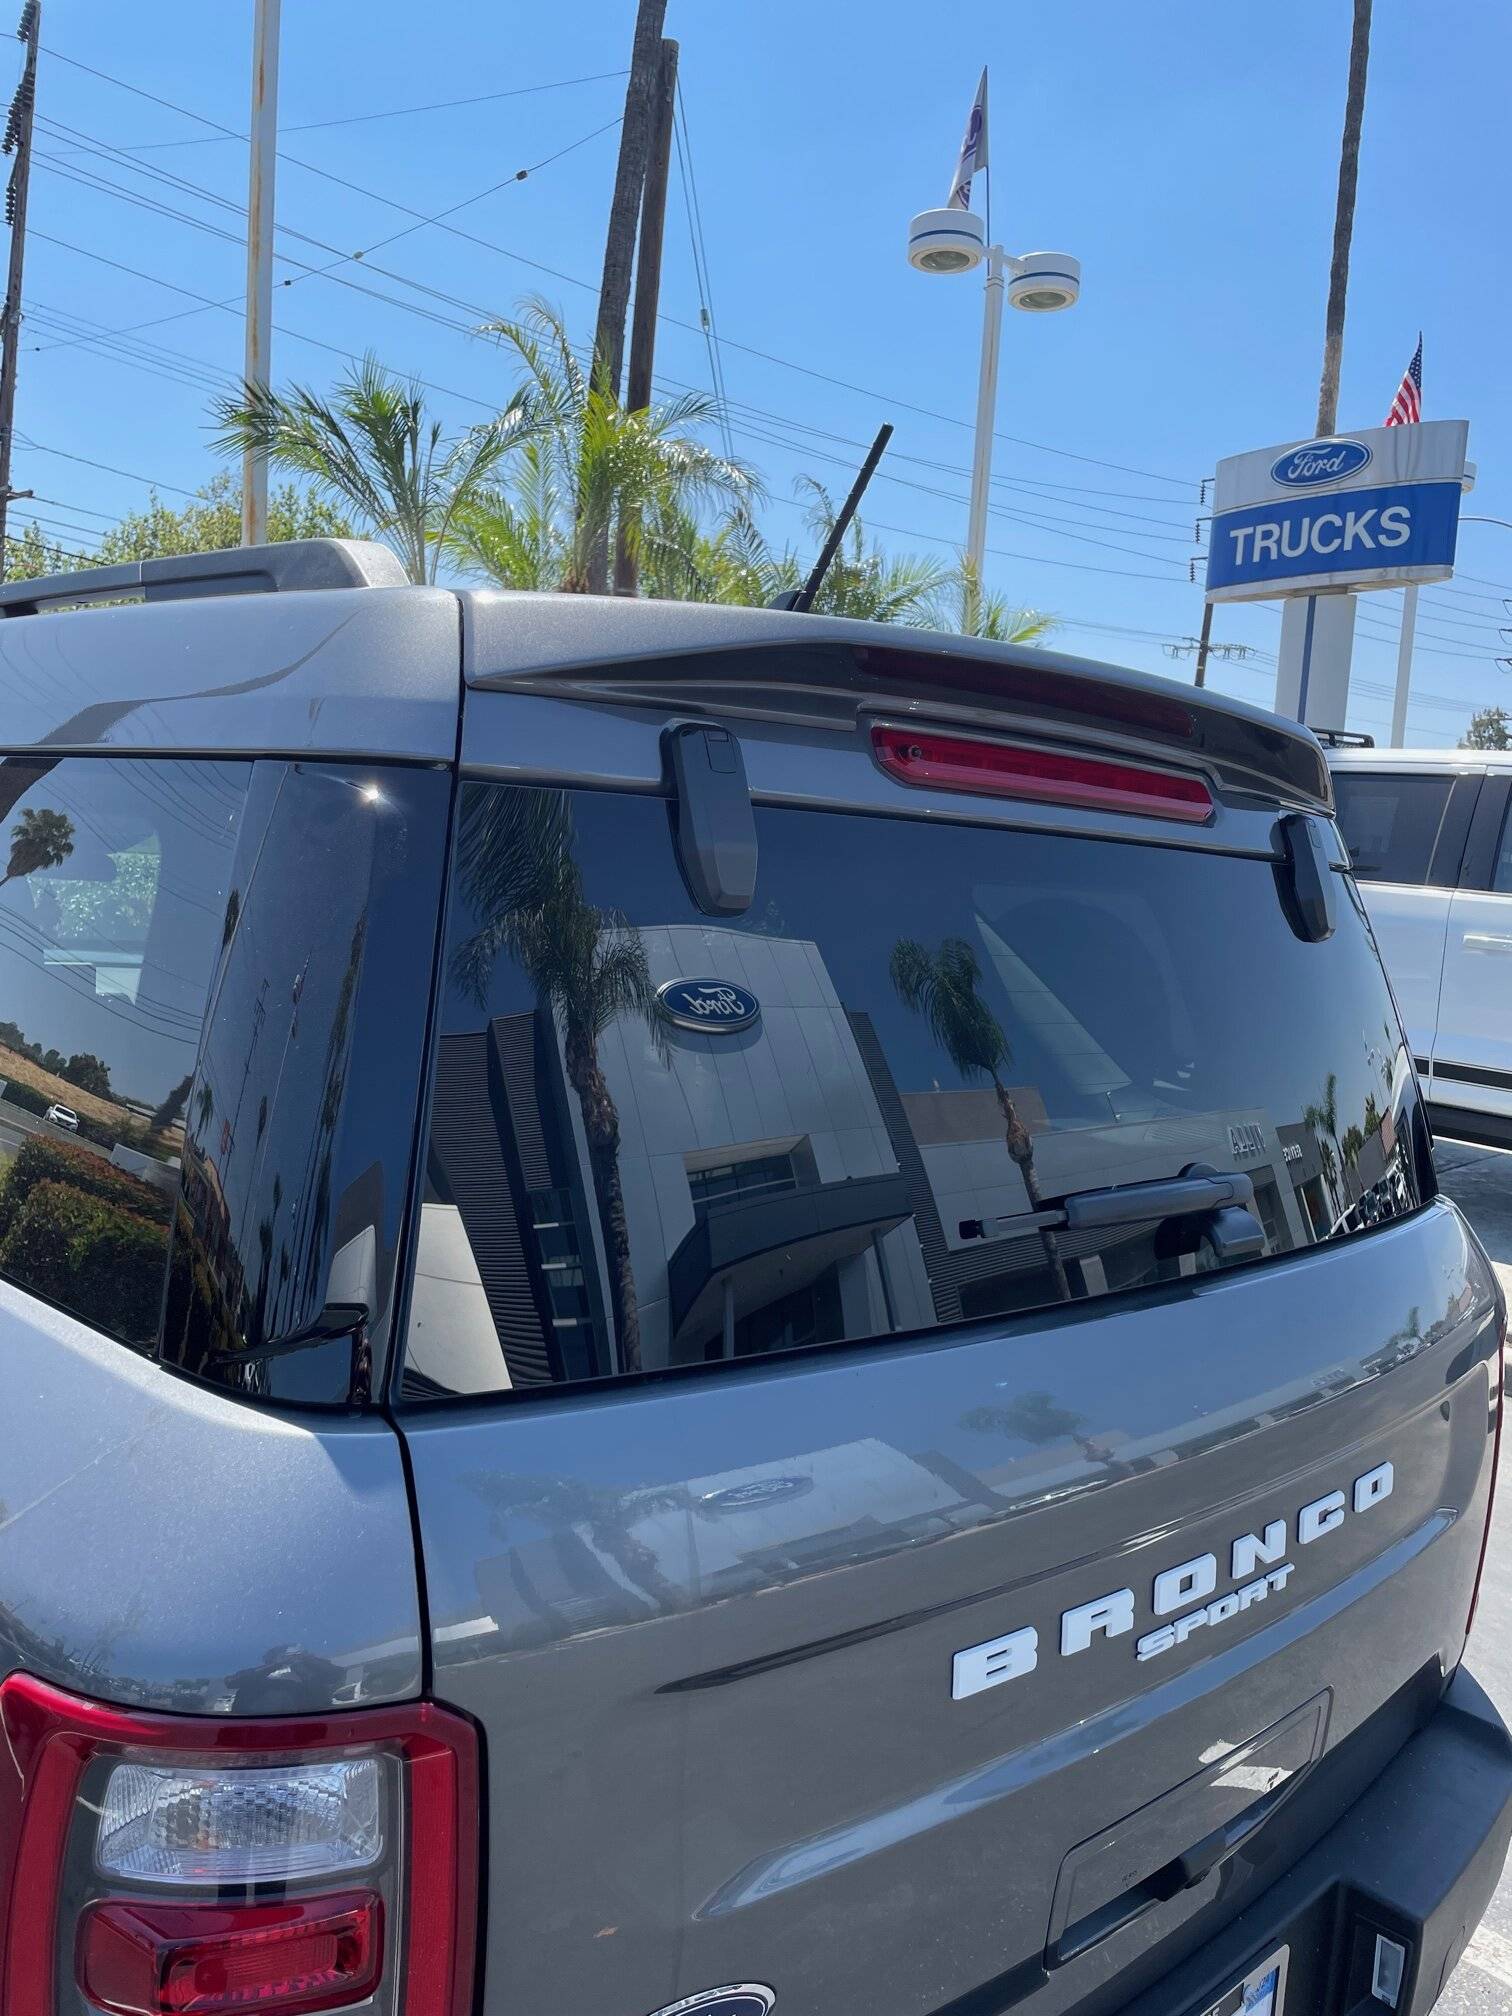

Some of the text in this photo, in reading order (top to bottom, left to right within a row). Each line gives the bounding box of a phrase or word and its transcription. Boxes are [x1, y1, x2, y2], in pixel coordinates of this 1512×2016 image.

[1289, 448, 1346, 479] Ford
[1230, 506, 1411, 566] TRUCKS
[951, 1461, 1395, 1700] BRONCO
[1136, 1562, 1296, 1662] SPORT
